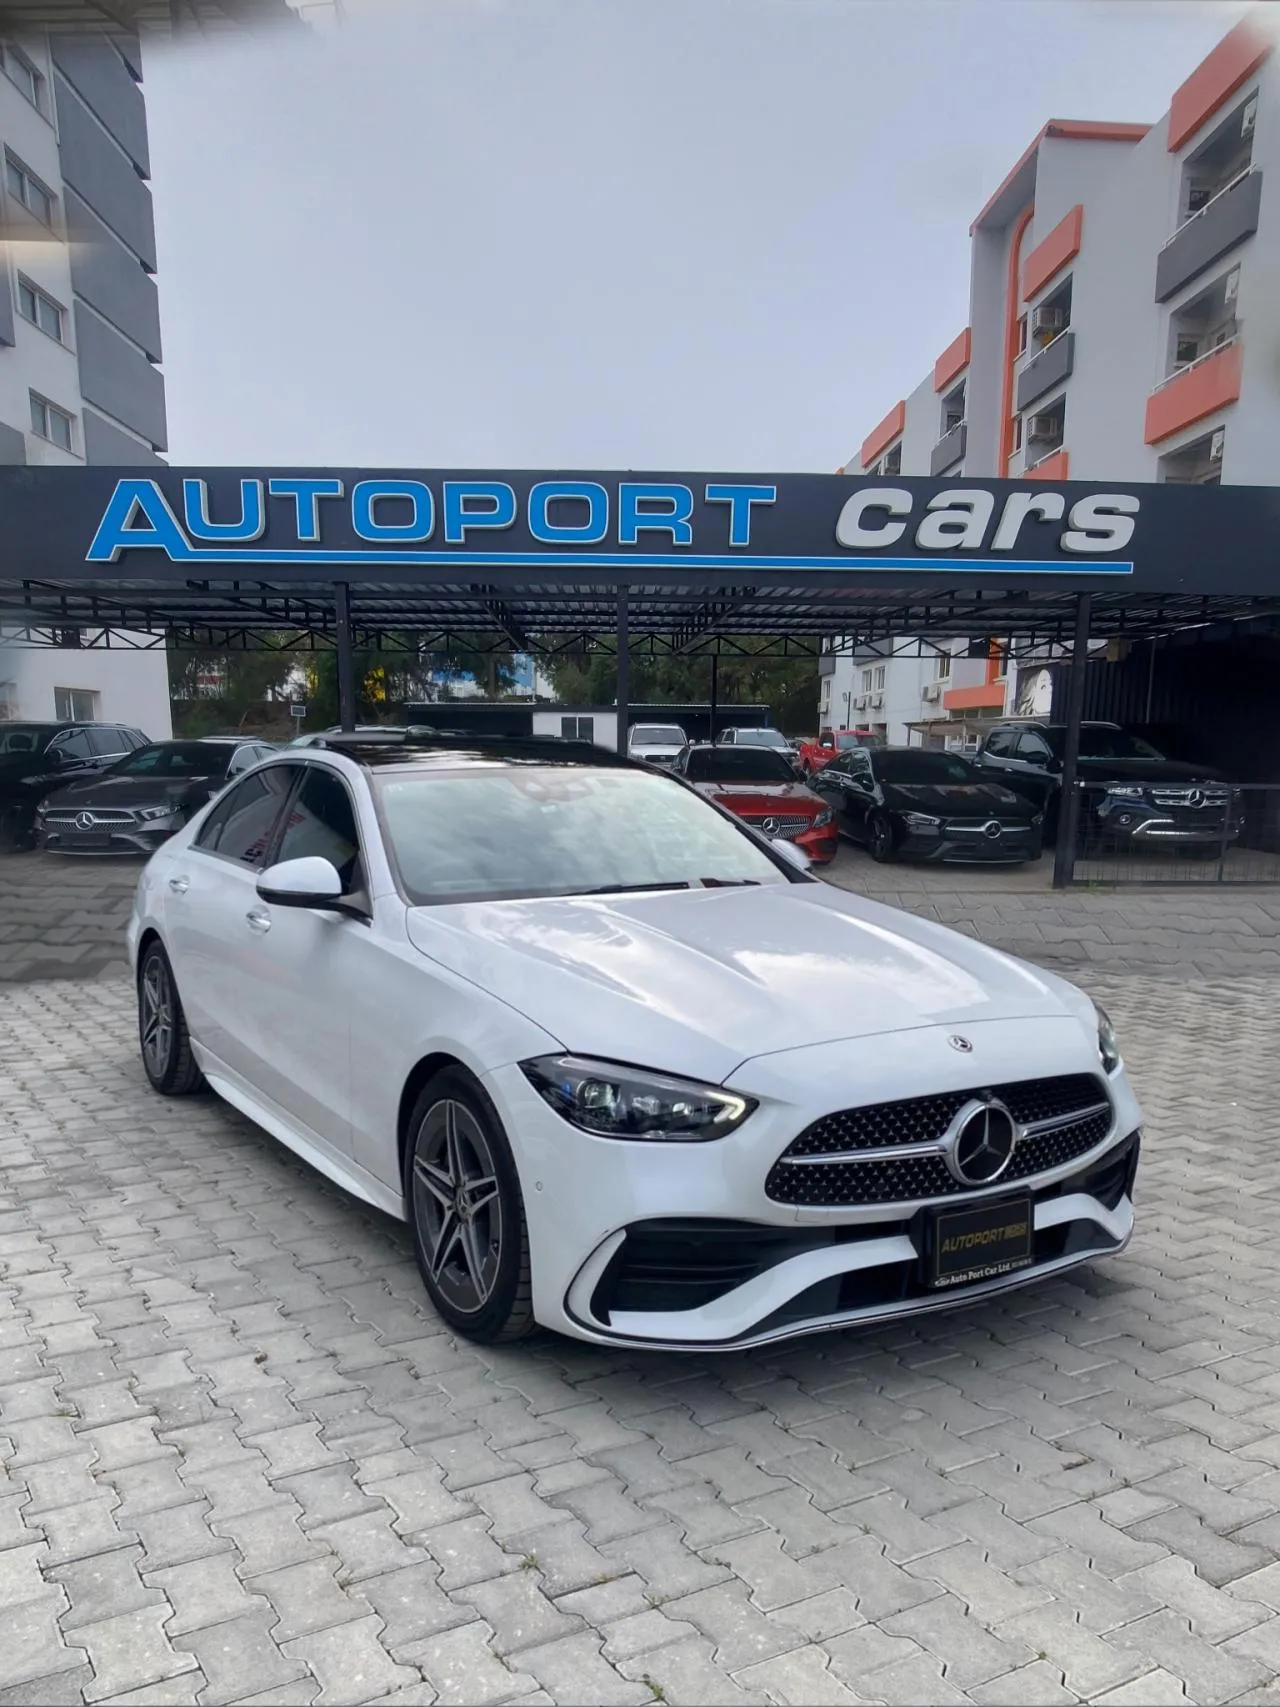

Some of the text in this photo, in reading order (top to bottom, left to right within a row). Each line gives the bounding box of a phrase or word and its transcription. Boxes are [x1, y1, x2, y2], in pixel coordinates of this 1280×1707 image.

[85, 477, 1141, 563] AUTOPORT cars
[941, 1227, 1005, 1253] AUTOPORT
[950, 1274, 967, 1284] Auto
[968, 1269, 984, 1280] Port
[984, 1267, 997, 1276] Car
